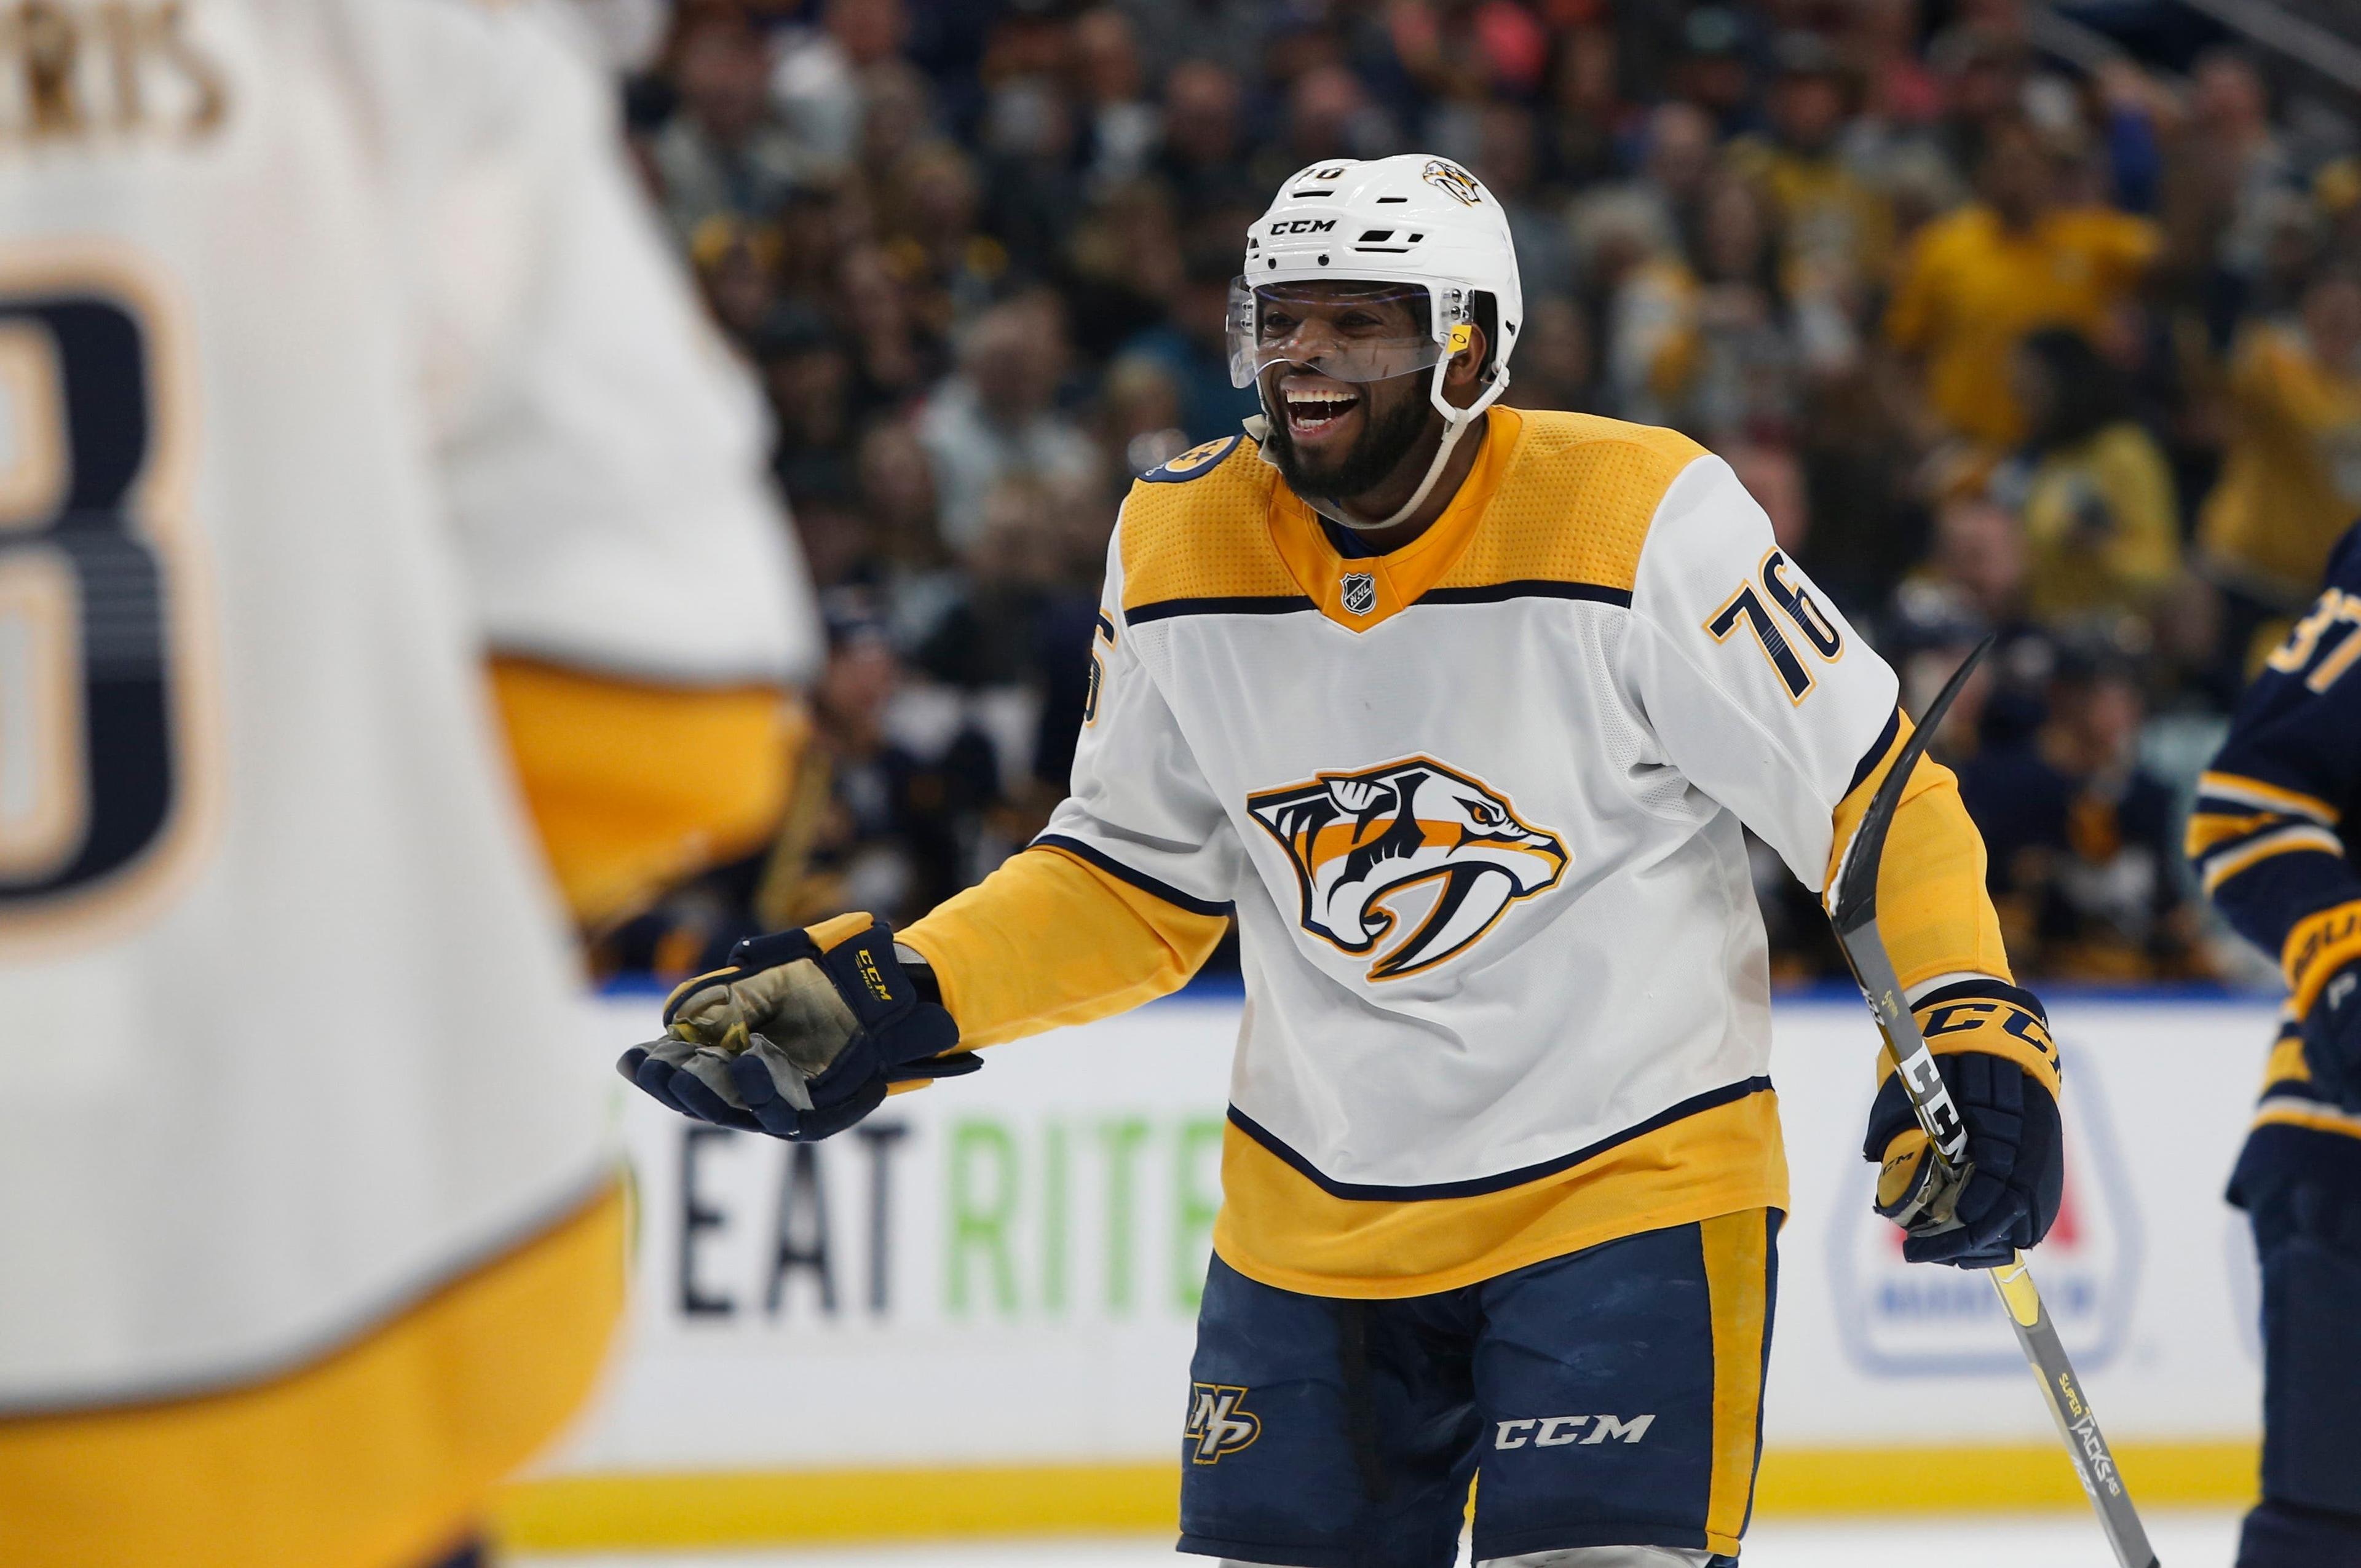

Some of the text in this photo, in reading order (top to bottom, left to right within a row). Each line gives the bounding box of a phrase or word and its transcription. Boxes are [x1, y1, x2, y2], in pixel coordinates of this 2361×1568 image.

[1270, 220, 1337, 236] CCM
[1350, 584, 1370, 606] NHL
[1701, 545, 1845, 707] 76
[859, 949, 893, 1000] CCM
[1922, 1002, 2062, 1085] CC
[679, 1118, 1224, 1316] EAT RITE
[2059, 1372, 2082, 1417] SUPER
[1495, 1414, 1656, 1451] CCM
[2067, 1406, 2112, 1483] TACKS
